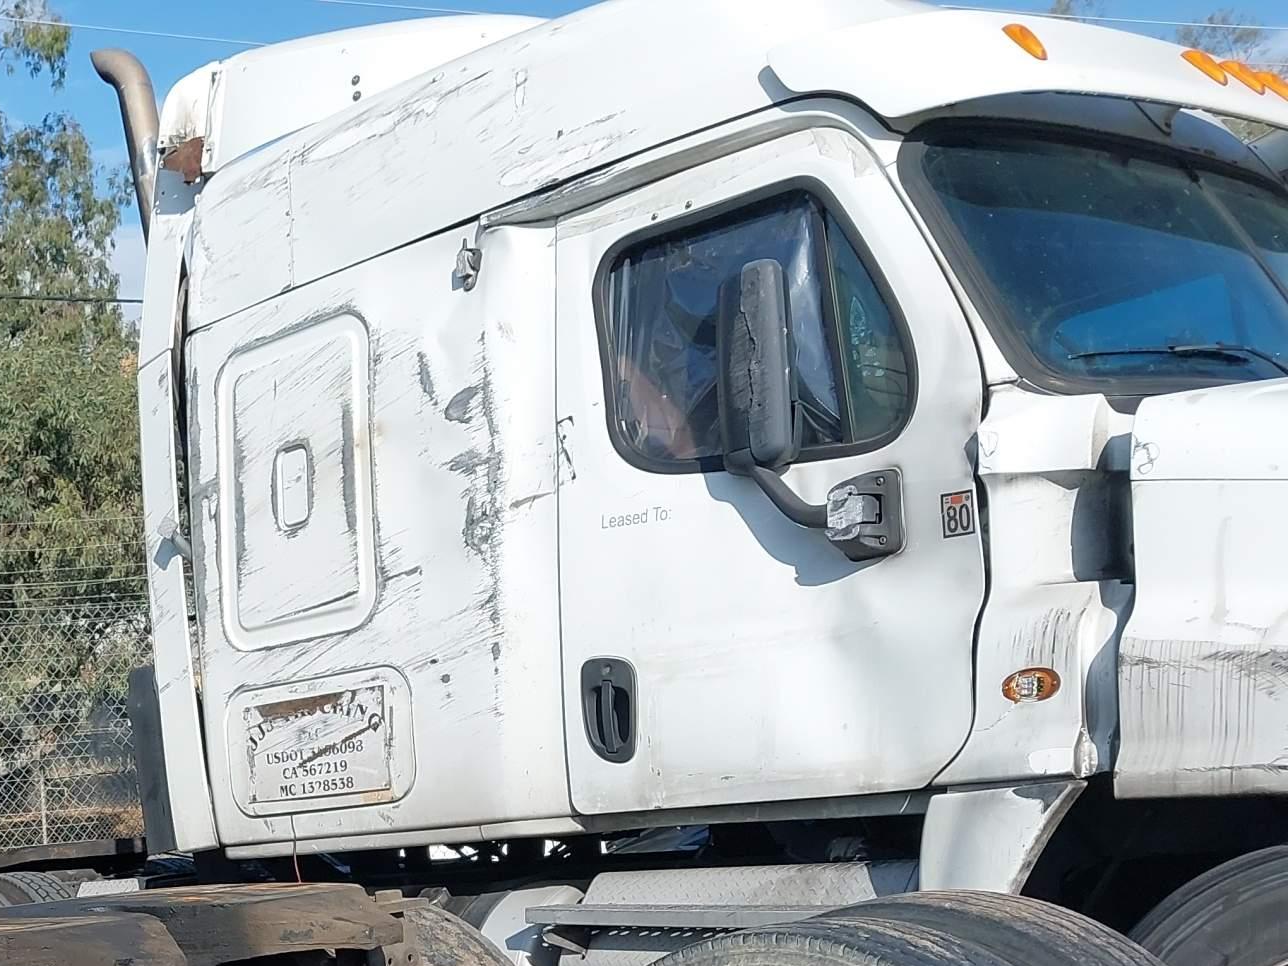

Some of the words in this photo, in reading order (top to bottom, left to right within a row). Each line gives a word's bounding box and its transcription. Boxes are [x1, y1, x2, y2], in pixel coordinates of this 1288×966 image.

[601, 508, 648, 529] Leased
[652, 506, 672, 521] To:
[946, 503, 971, 533] 80
[266, 748, 304, 765] USDOT
[282, 766, 298, 780] CA
[301, 759, 349, 778] 567219
[279, 783, 297, 798] MC
